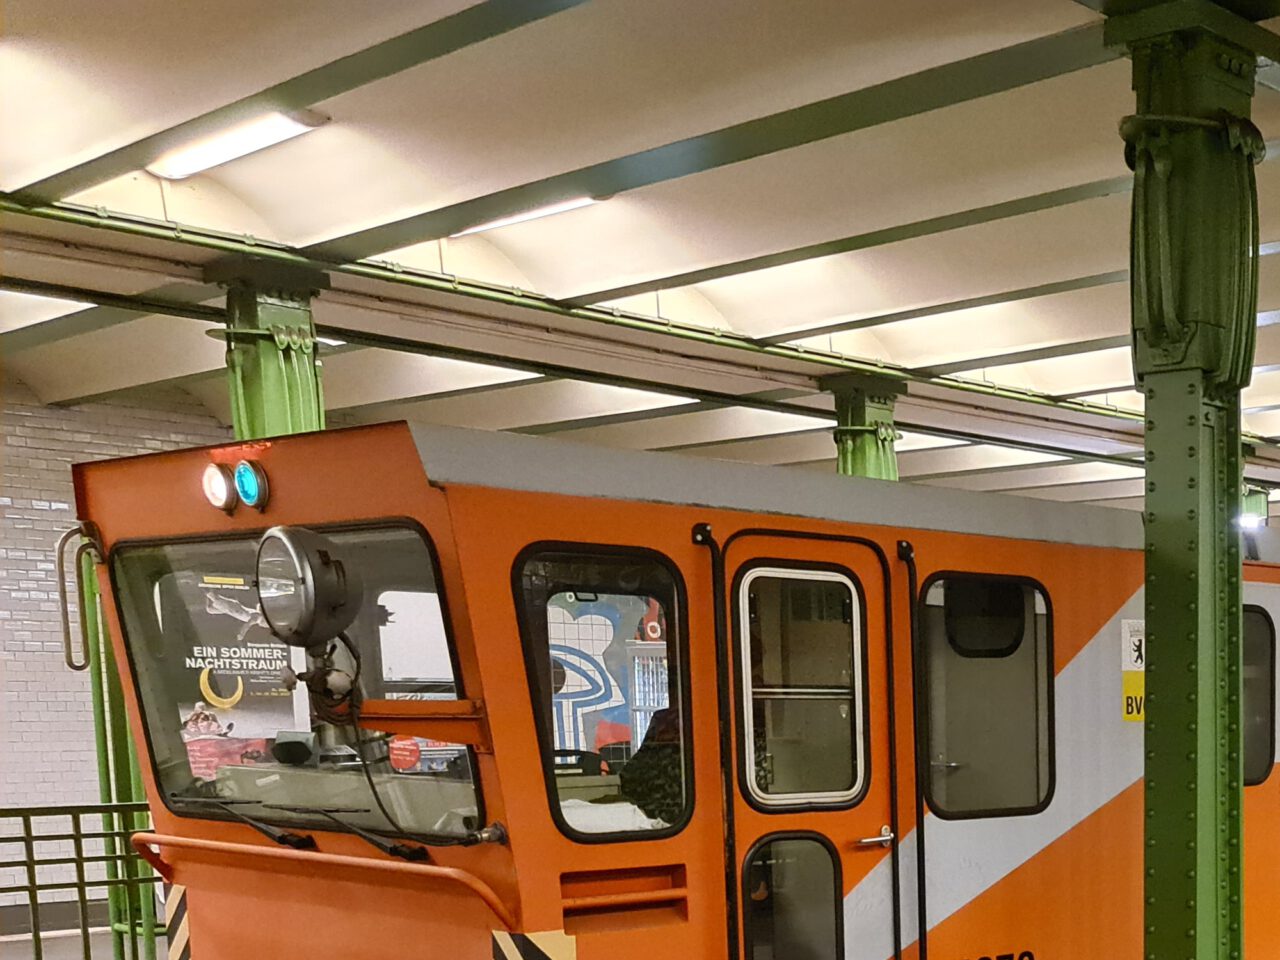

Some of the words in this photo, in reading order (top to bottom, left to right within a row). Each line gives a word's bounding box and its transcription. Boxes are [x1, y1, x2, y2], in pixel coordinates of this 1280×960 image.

[193, 646, 217, 658] EIN
[220, 647, 288, 659] SOMMER-
[185, 657, 288, 670] NACHTSTRAUM
[1126, 696, 1145, 715] BV
